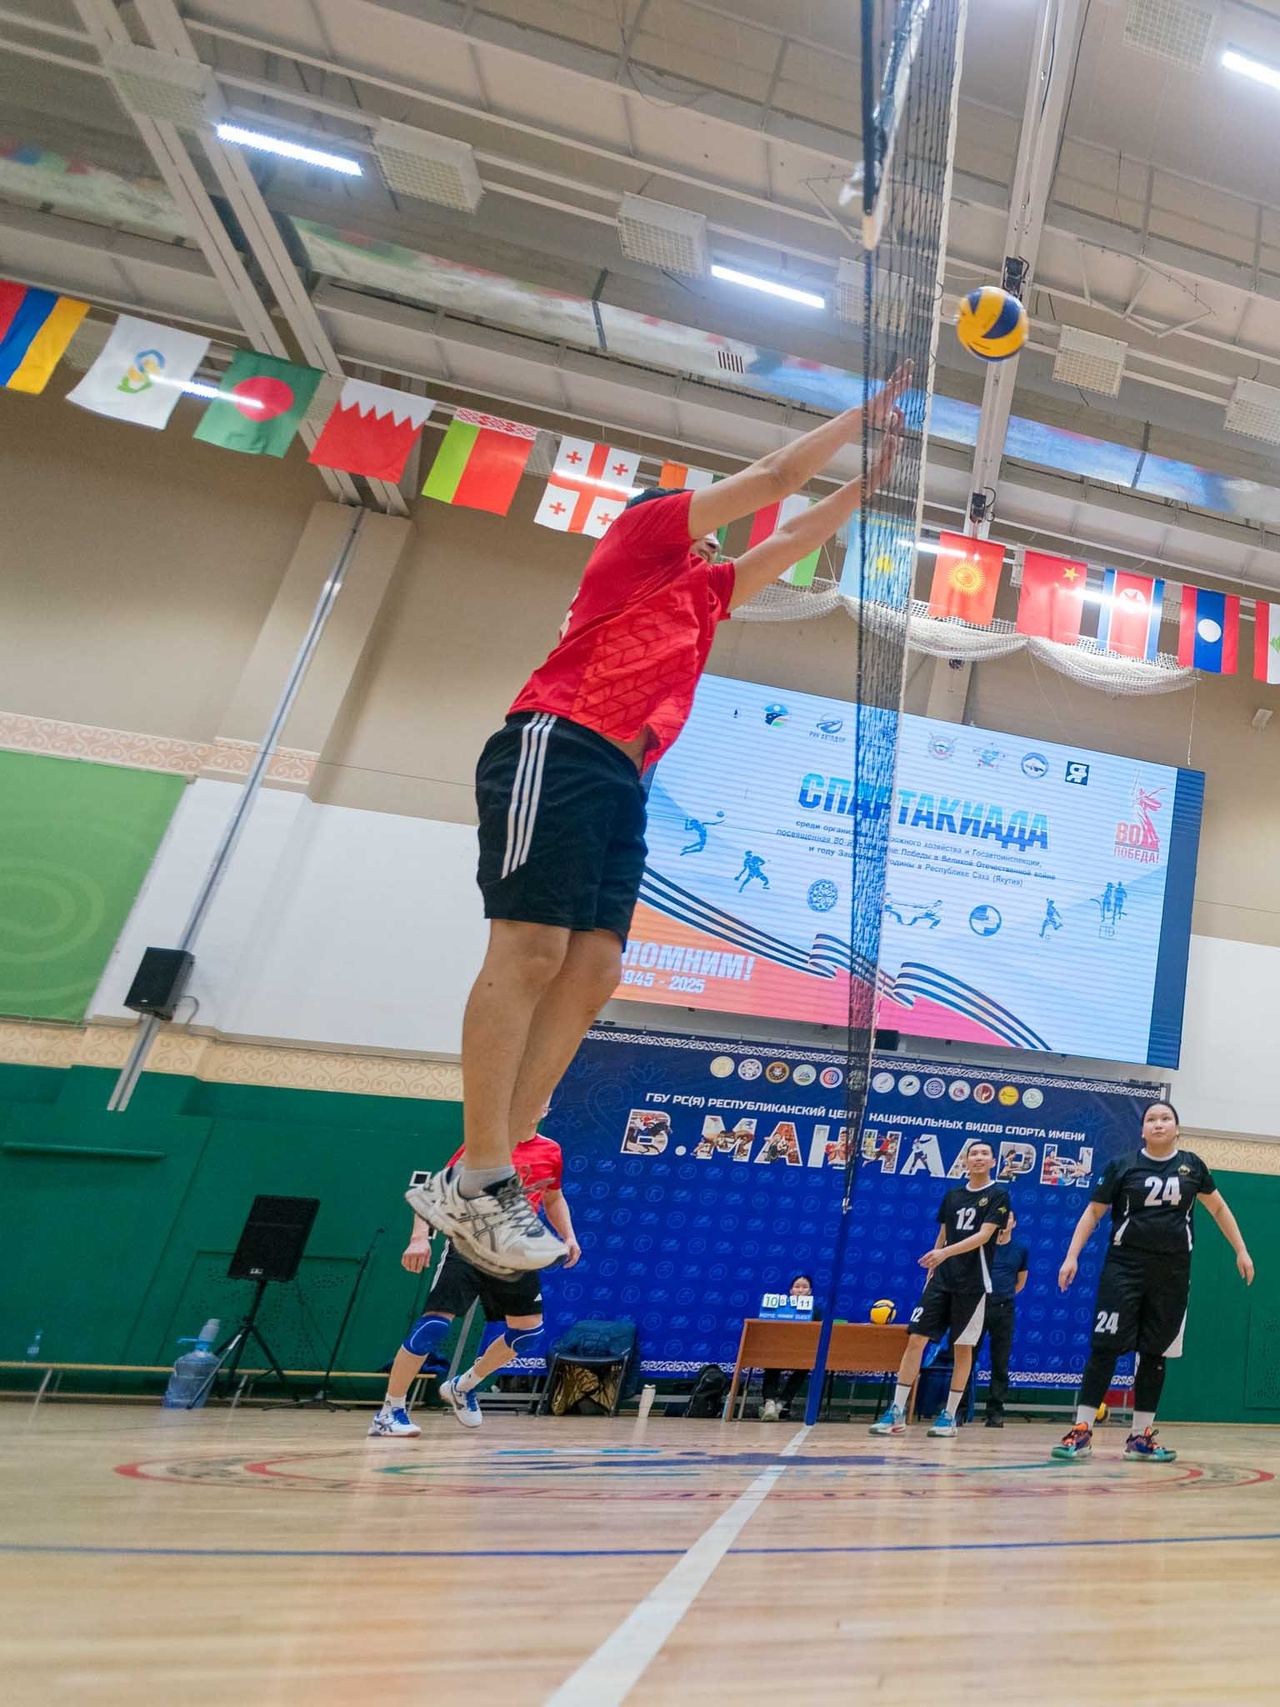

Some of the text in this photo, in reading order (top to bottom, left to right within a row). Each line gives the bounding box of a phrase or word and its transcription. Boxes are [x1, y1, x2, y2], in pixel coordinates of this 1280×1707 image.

[796, 820, 821, 830] среди
[1115, 822, 1142, 846] 80
[817, 847, 835, 857] году
[941, 854, 974, 868] Великой
[1113, 846, 1160, 864] ПОБЕДА!
[972, 871, 990, 881] Саха
[992, 874, 1024, 887] (Якутия)
[667, 975, 706, 994] 2025
[645, 1092, 671, 1103] ГБУ
[672, 1094, 706, 1109] РС(Я)
[708, 1097, 827, 1118] РЕСПУБЛИКАНСКИЙ
[869, 1112, 964, 1131] НАЦИОНАЛЬНЫХ
[965, 1121, 1004, 1134] ВИДОВ
[1005, 1125, 1047, 1139] СПОРТА
[1048, 1130, 1087, 1142] ИМЕНИ
[1144, 1175, 1182, 1207] 24
[956, 1207, 976, 1231] 12
[766, 1296, 778, 1307] 10
[800, 1300, 810, 1308] 11
[910, 1306, 924, 1323] 12
[1095, 1311, 1120, 1335] 24
